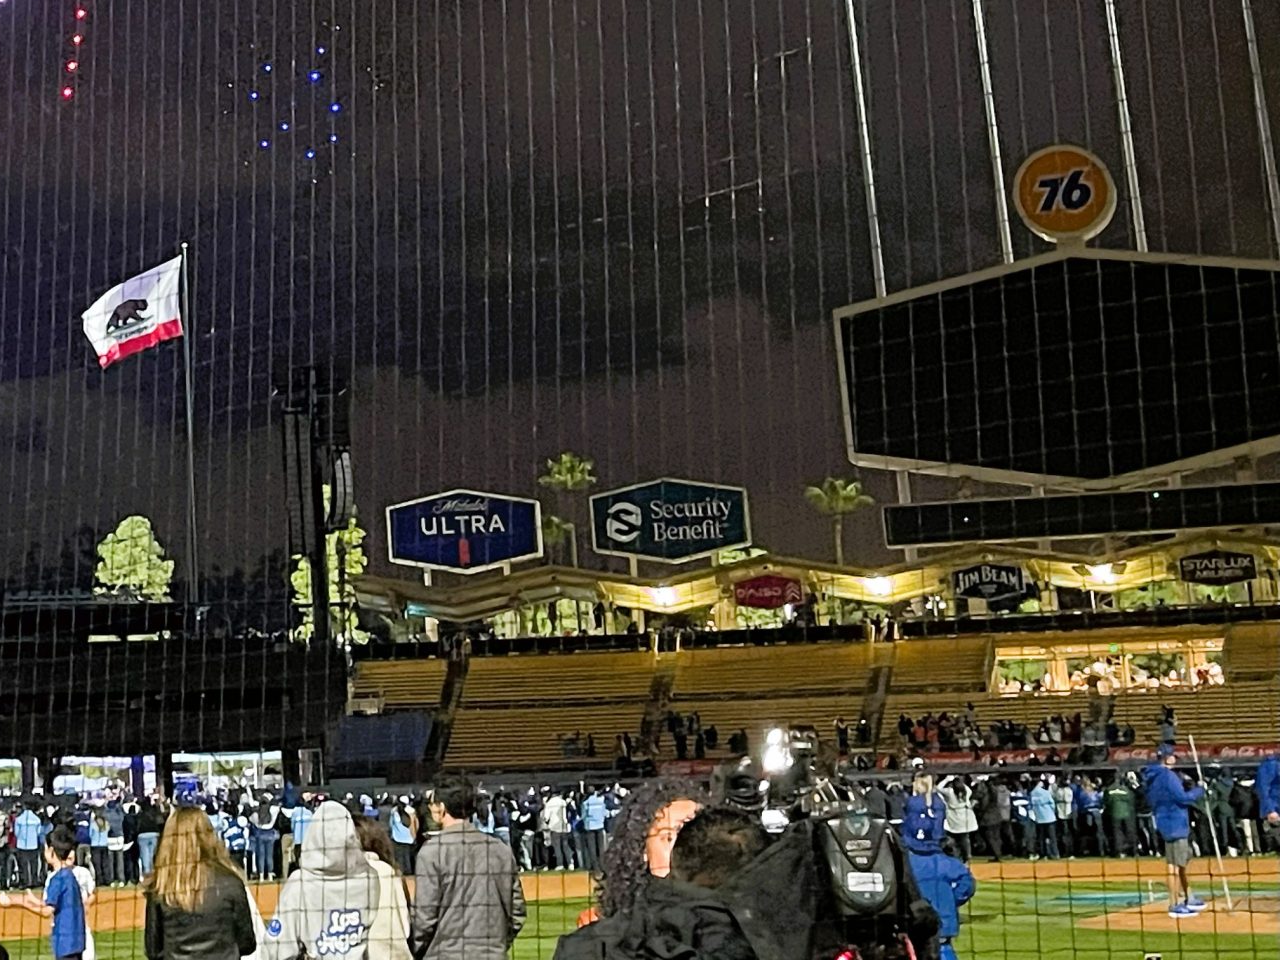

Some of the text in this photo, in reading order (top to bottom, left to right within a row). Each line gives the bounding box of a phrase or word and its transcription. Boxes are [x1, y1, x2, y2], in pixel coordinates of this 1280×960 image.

[1035, 168, 1092, 214] 76
[651, 499, 731, 521] Security
[421, 514, 506, 536] ULTRA
[654, 521, 719, 541] Benefit
[1182, 557, 1252, 571] STARLUX
[956, 565, 1019, 594] JIM BEAM
